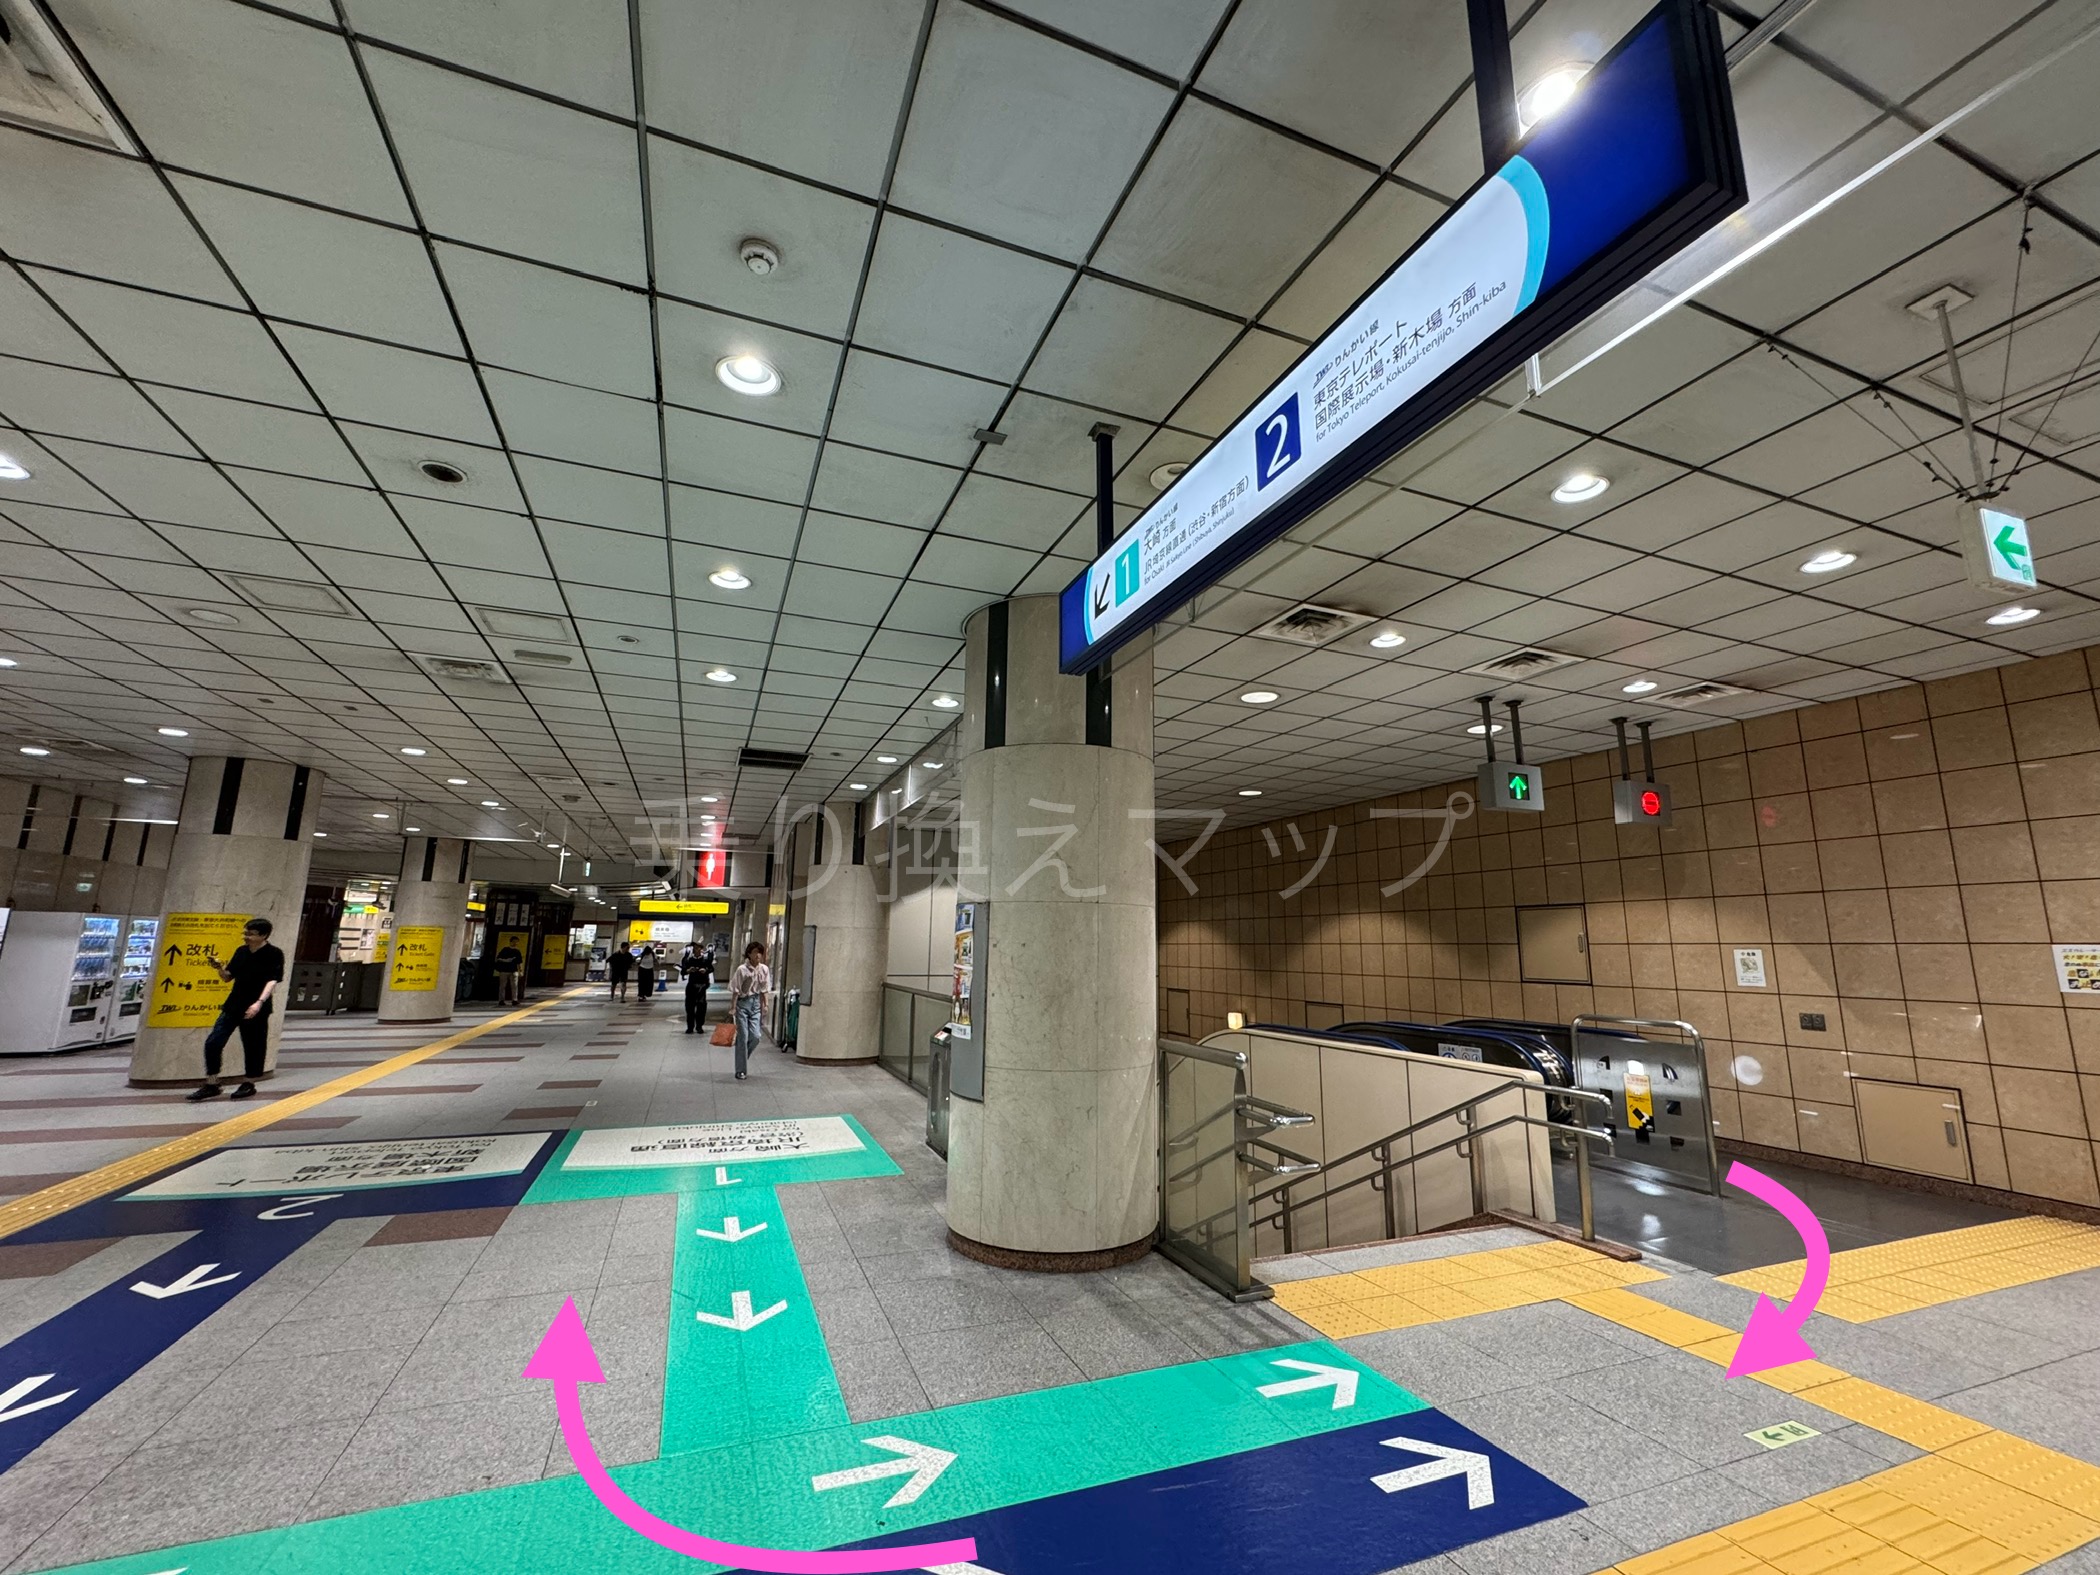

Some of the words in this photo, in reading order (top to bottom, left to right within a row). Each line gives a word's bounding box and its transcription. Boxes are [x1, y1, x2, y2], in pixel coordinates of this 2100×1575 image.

[1315, 307, 1442, 430] 国際展示場・新木場
[1448, 282, 1477, 318] 方面
[1316, 431, 1326, 442] for
[1327, 412, 1350, 432] Tokyo
[1350, 383, 1384, 414] Teleport,
[1386, 326, 1454, 385] Kokusai-tenjijo,
[1456, 282, 1506, 328] Shin-kiba
[1334, 319, 1380, 366] りんかい線
[1314, 320, 1408, 411] 東京テレポート
[1265, 414, 1290, 478] 2
[1144, 530, 1160, 556] 大崎
[1162, 518, 1176, 540] 方面
[1122, 553, 1130, 595] 1
[186, 944, 219, 956] 改札
[756, 1142, 809, 1151] 大崎
[216, 1164, 469, 1187] 東京テレポート
[257, 1194, 344, 1220] 2
